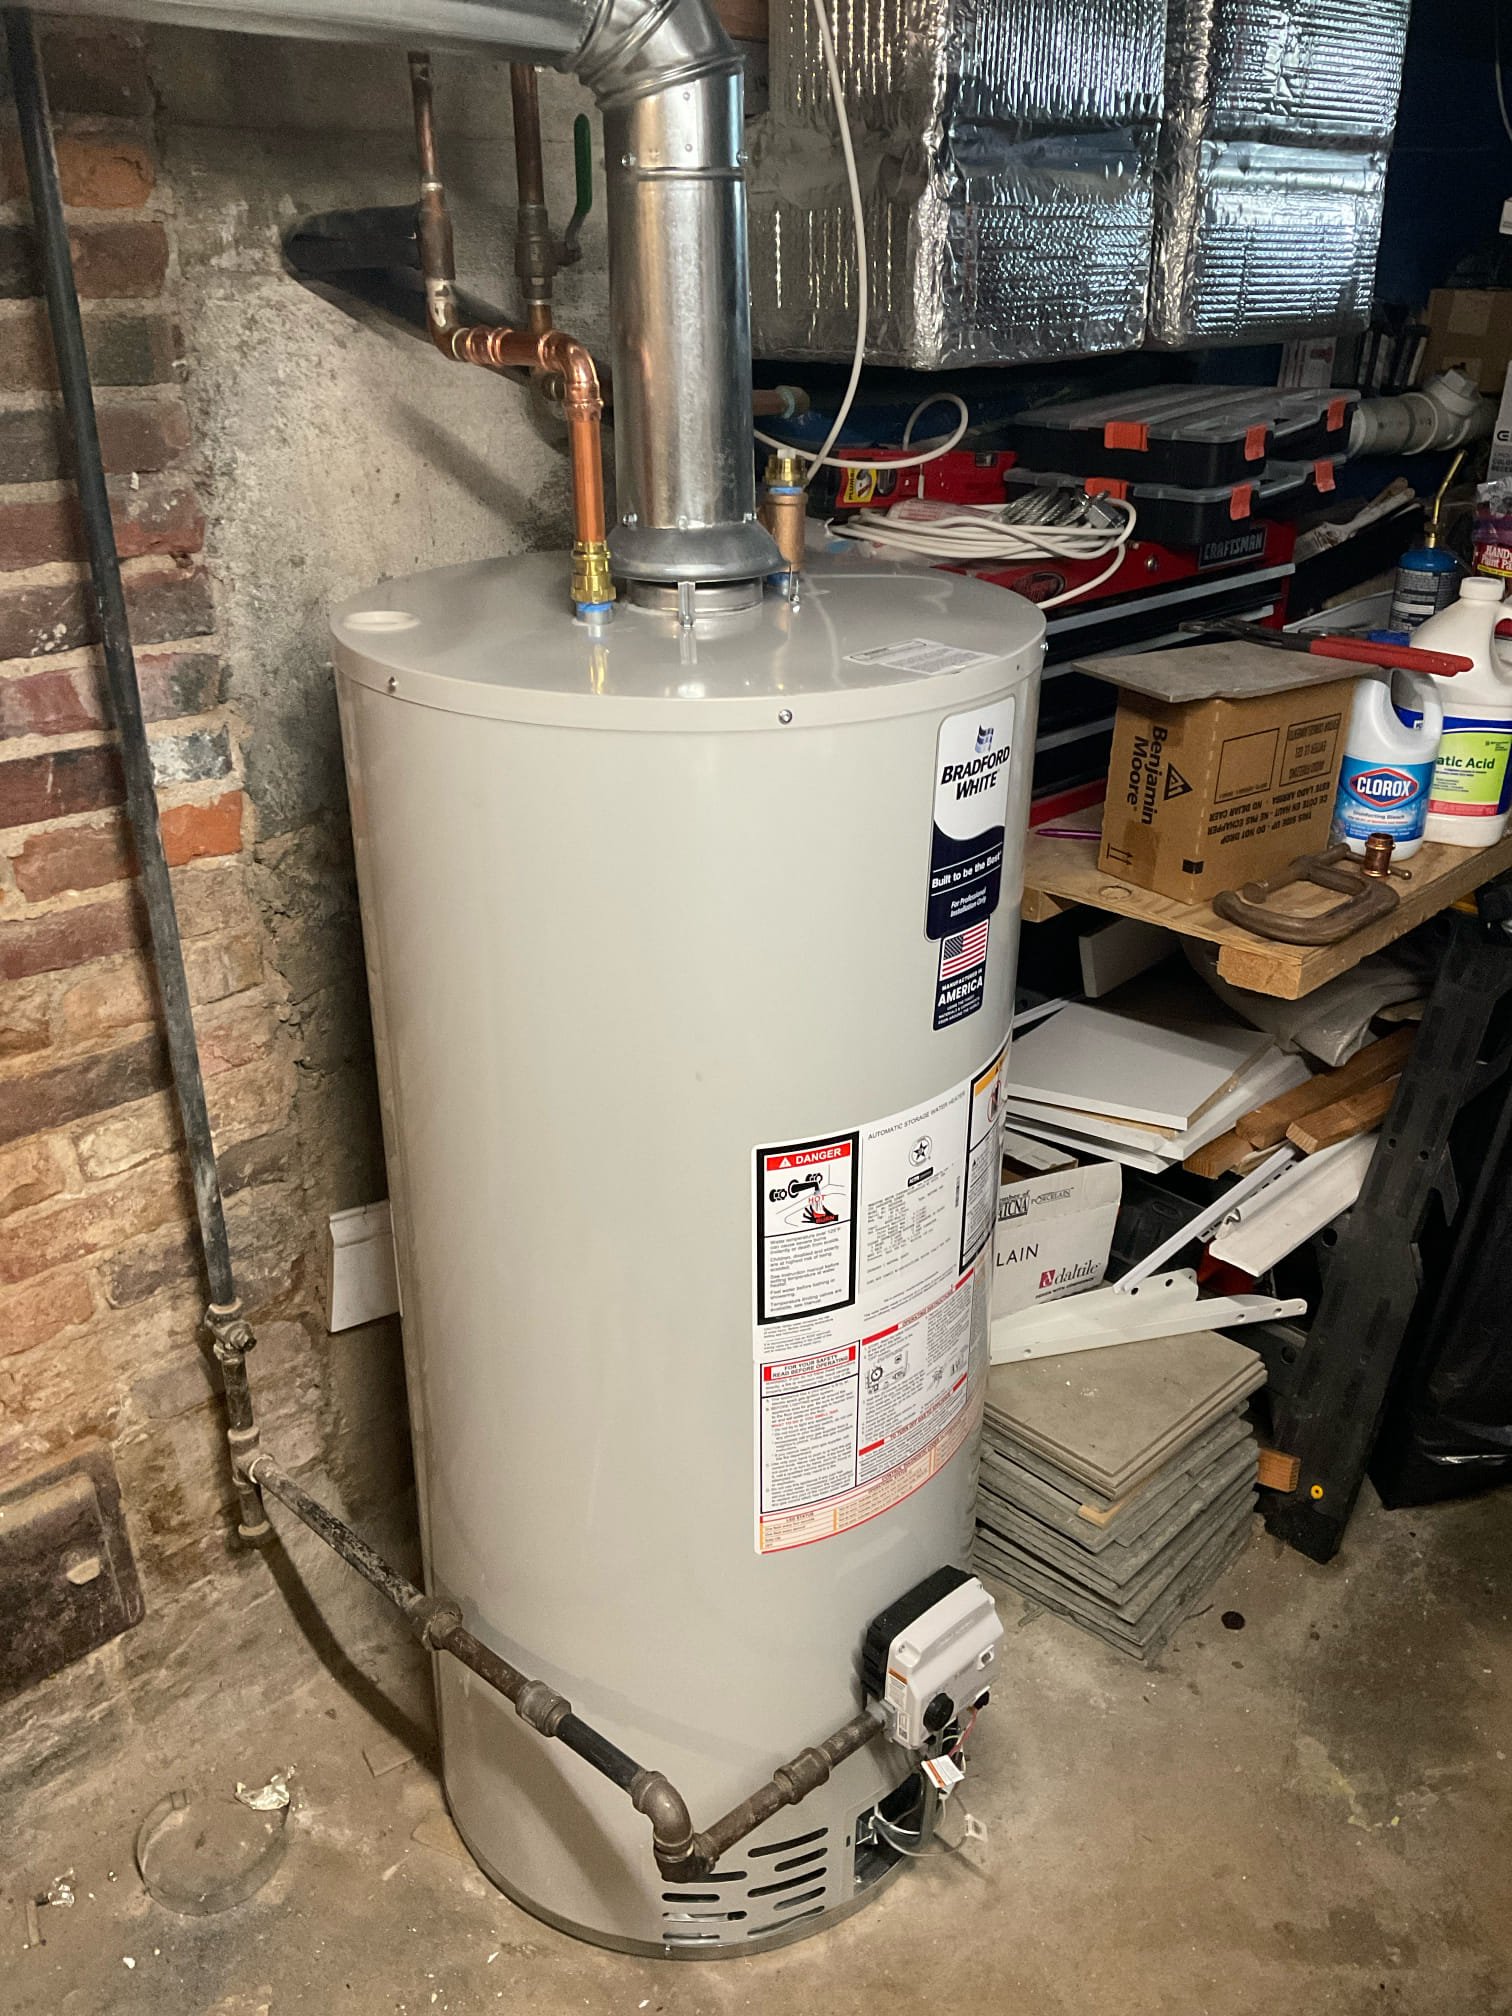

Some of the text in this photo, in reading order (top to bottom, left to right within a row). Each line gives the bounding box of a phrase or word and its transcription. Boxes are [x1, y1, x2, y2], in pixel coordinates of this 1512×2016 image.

[1203, 531, 1263, 560] CRAFTSMAN
[941, 745, 1010, 785] BRADFORD
[1127, 735, 1149, 806] Moore
[1465, 757, 1496, 769] Acid
[956, 771, 998, 801] WHITE
[1141, 726, 1168, 825] Benjamin
[1356, 777, 1411, 797] CLOROX
[1209, 810, 1228, 822] CAER
[1230, 803, 1251, 816] DEJAR
[1252, 800, 1263, 810] NO
[1274, 804, 1291, 817] HAUT
[1207, 818, 1245, 836] ECHAPPER
[1220, 811, 1312, 845] THIS SIDE UP DO NOT DROP
[1245, 814, 1259, 825] PAS
[931, 852, 1001, 889] Built to be the Best
[938, 975, 983, 1007] AMERICA
[868, 1123, 903, 1140] AUTOMATIC
[904, 1112, 930, 1128] STORAGE
[930, 1102, 948, 1115] WATER
[796, 1147, 842, 1165] DANGER
[808, 1195, 825, 1205] HOT
[996, 1243, 1039, 1267] LAIN
[1055, 1259, 1098, 1285] daltile
[772, 1355, 849, 1378] READ BEFORE OPERATING
[798, 1360, 815, 1369] YOUR
[816, 1354, 838, 1364] SAFETY
